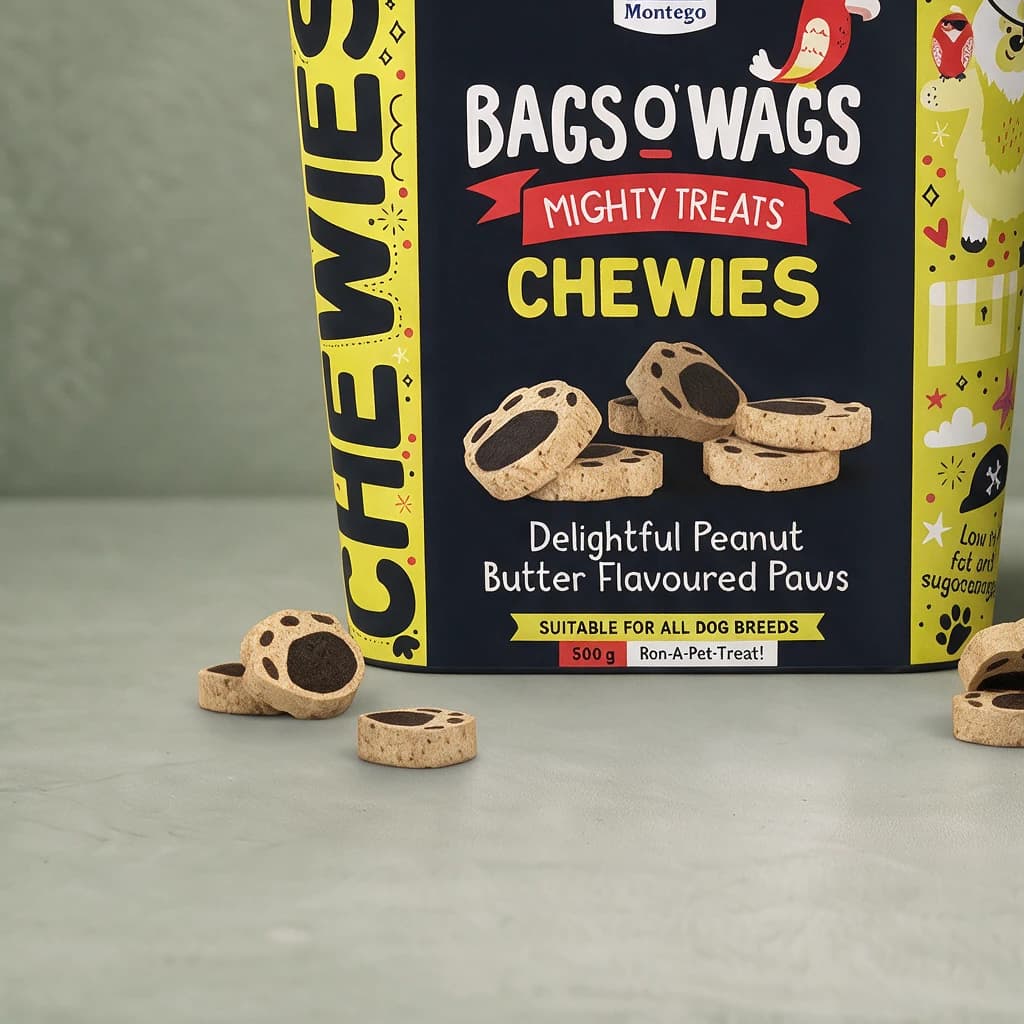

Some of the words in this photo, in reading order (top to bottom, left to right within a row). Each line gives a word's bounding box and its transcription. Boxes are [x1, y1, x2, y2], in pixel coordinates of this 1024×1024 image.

[624, 3, 707, 24] Montego
[466, 84, 627, 168] BAGS
[687, 84, 861, 165] WAGS
[543, 187, 666, 229] MIGHTY
[675, 188, 785, 230] TREATS
[507, 256, 820, 318] CHEWIES
[529, 520, 681, 561] Delightful
[694, 520, 804, 553] Peanut
[960, 523, 986, 547] Low
[484, 561, 586, 592] Butter
[599, 561, 757, 593] Flavoured
[769, 559, 849, 592] Paws
[539, 620, 618, 635] SUITABLE
[624, 620, 655, 635] FOR
[660, 620, 690, 635] ALL
[695, 620, 729, 634] DOG
[734, 620, 799, 634] BREEDS
[572, 646, 602, 661] 500
[605, 649, 615, 664] g
[639, 646, 764, 661] Ron-A-Pet-Treat!
